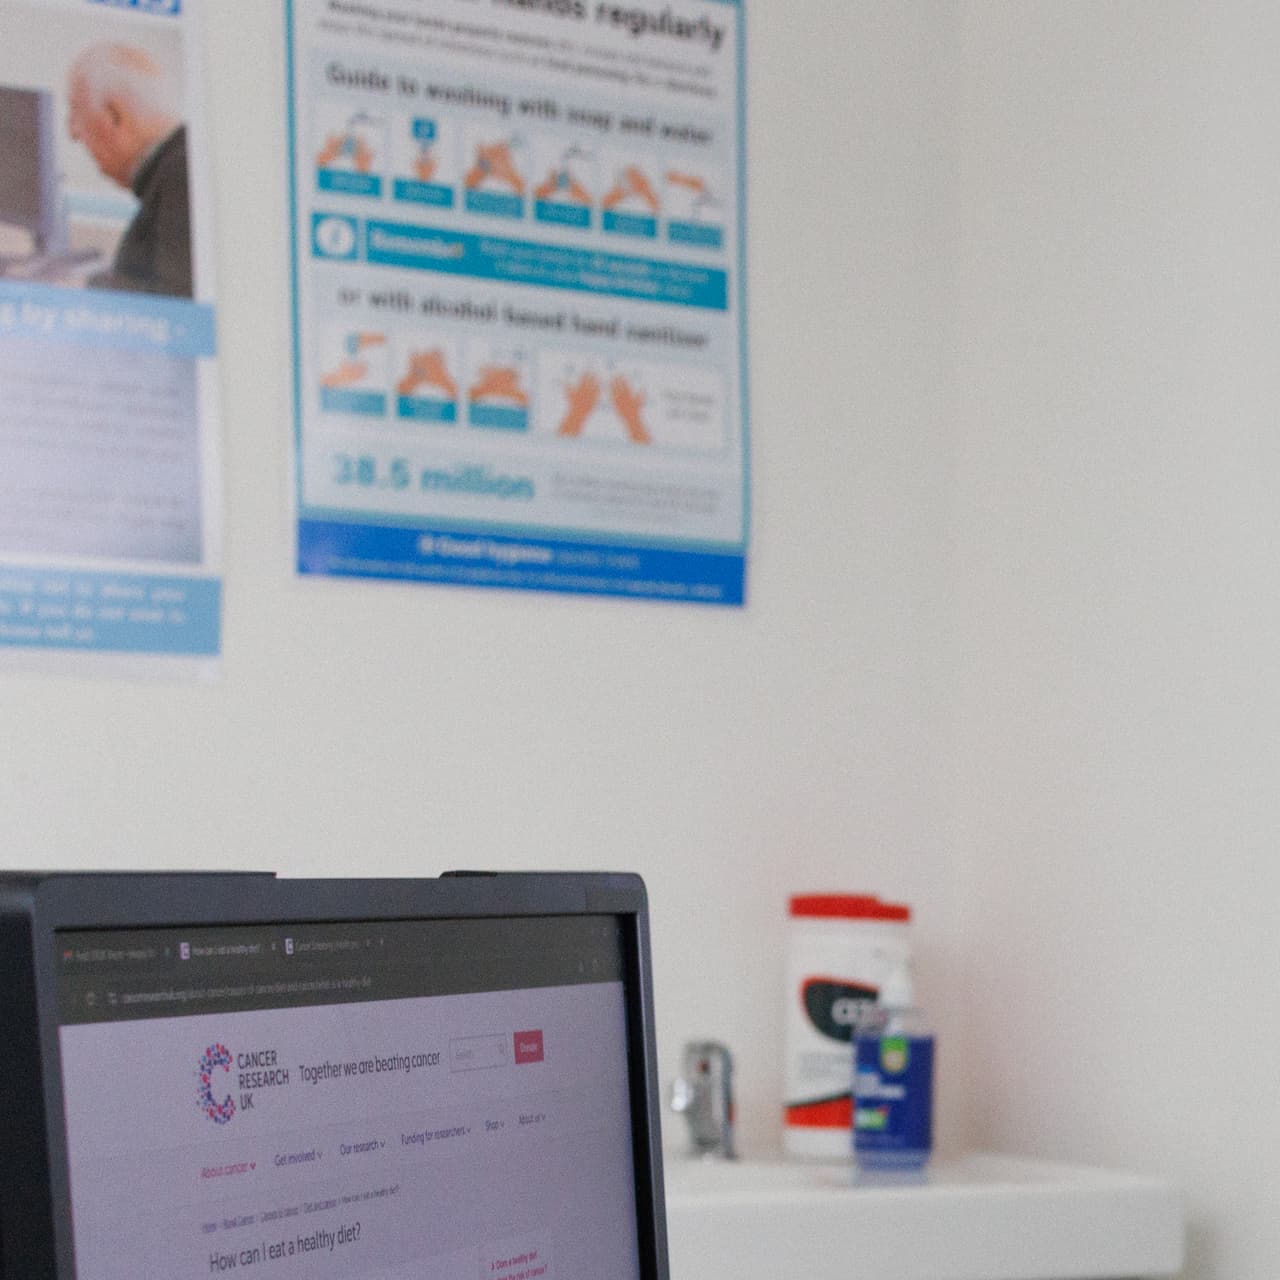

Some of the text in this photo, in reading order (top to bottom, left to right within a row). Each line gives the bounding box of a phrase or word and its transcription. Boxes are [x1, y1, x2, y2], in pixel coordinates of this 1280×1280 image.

[237, 1050, 277, 1069] CANCER
[299, 1061, 342, 1084] Together
[344, 1061, 358, 1076] we
[358, 1059, 374, 1075] are
[375, 1053, 411, 1073] beating
[411, 1051, 441, 1068] cancer
[238, 1069, 289, 1089] RESEARCH
[240, 1092, 254, 1111] UK
[400, 1132, 425, 1145] Funding
[339, 1143, 351, 1155] Our
[274, 1154, 287, 1167] Get
[209, 1221, 361, 1272] How can I eat a healthy diet?
